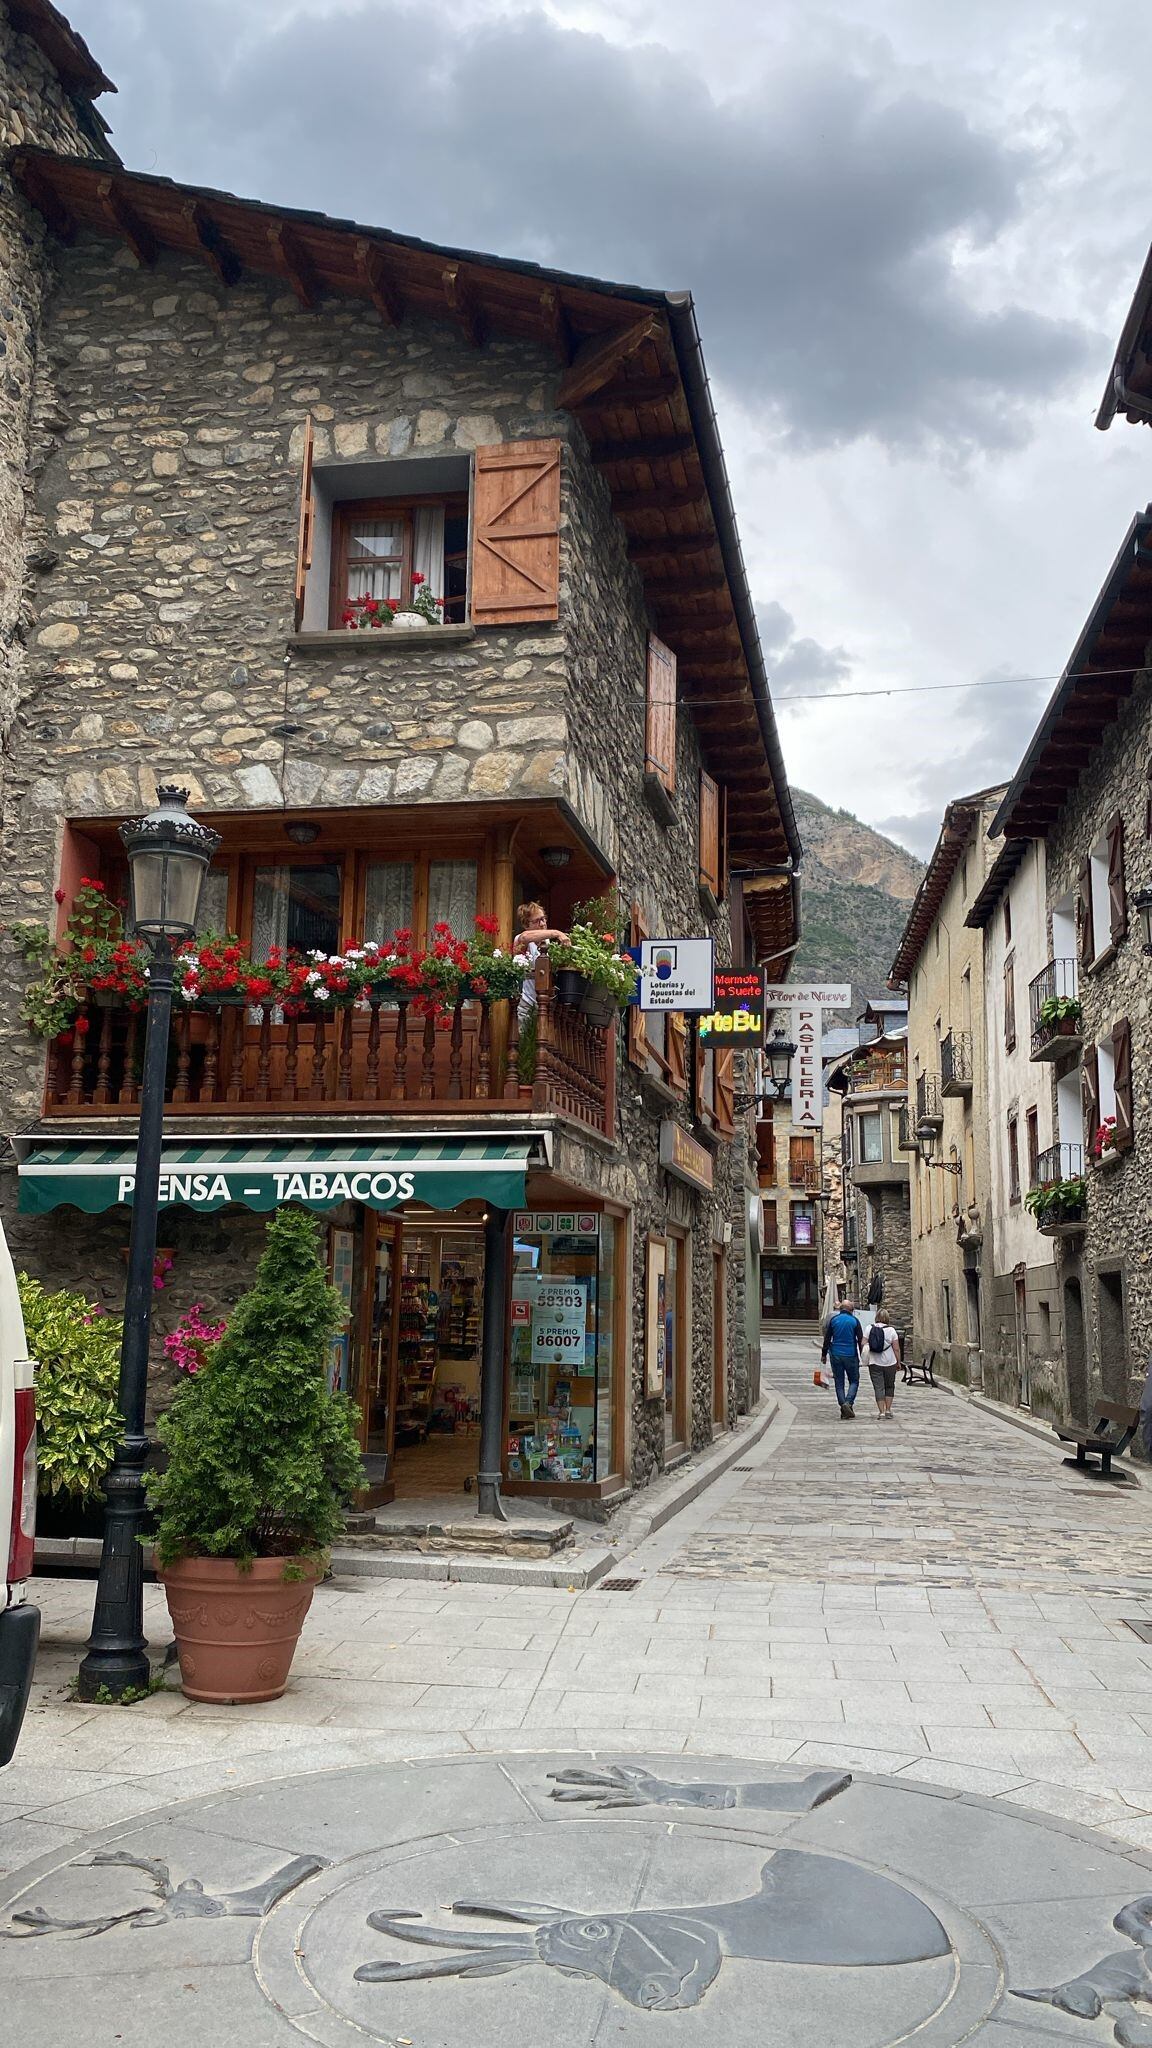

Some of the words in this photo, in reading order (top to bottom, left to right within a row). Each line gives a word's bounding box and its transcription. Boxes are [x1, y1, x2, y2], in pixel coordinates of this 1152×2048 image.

[715, 974, 758, 984] Marmota
[650, 981, 679, 989] Loterías
[680, 982, 685, 990] y
[650, 989, 683, 997] Apuestas
[717, 988, 726, 996] la
[727, 987, 761, 996] Suerte
[767, 990, 797, 1002] Flor
[797, 991, 810, 1001] de
[811, 991, 848, 1002] Nieve
[799, 1012, 815, 1121] PASTELERIA
[117, 1174, 232, 1202] PENSA
[272, 1172, 416, 1201] TABACOS
[547, 1288, 580, 1296] PREMIO
[537, 1295, 583, 1308] 58303
[546, 1328, 578, 1336] PREMIO
[536, 1335, 581, 1347] 86007
